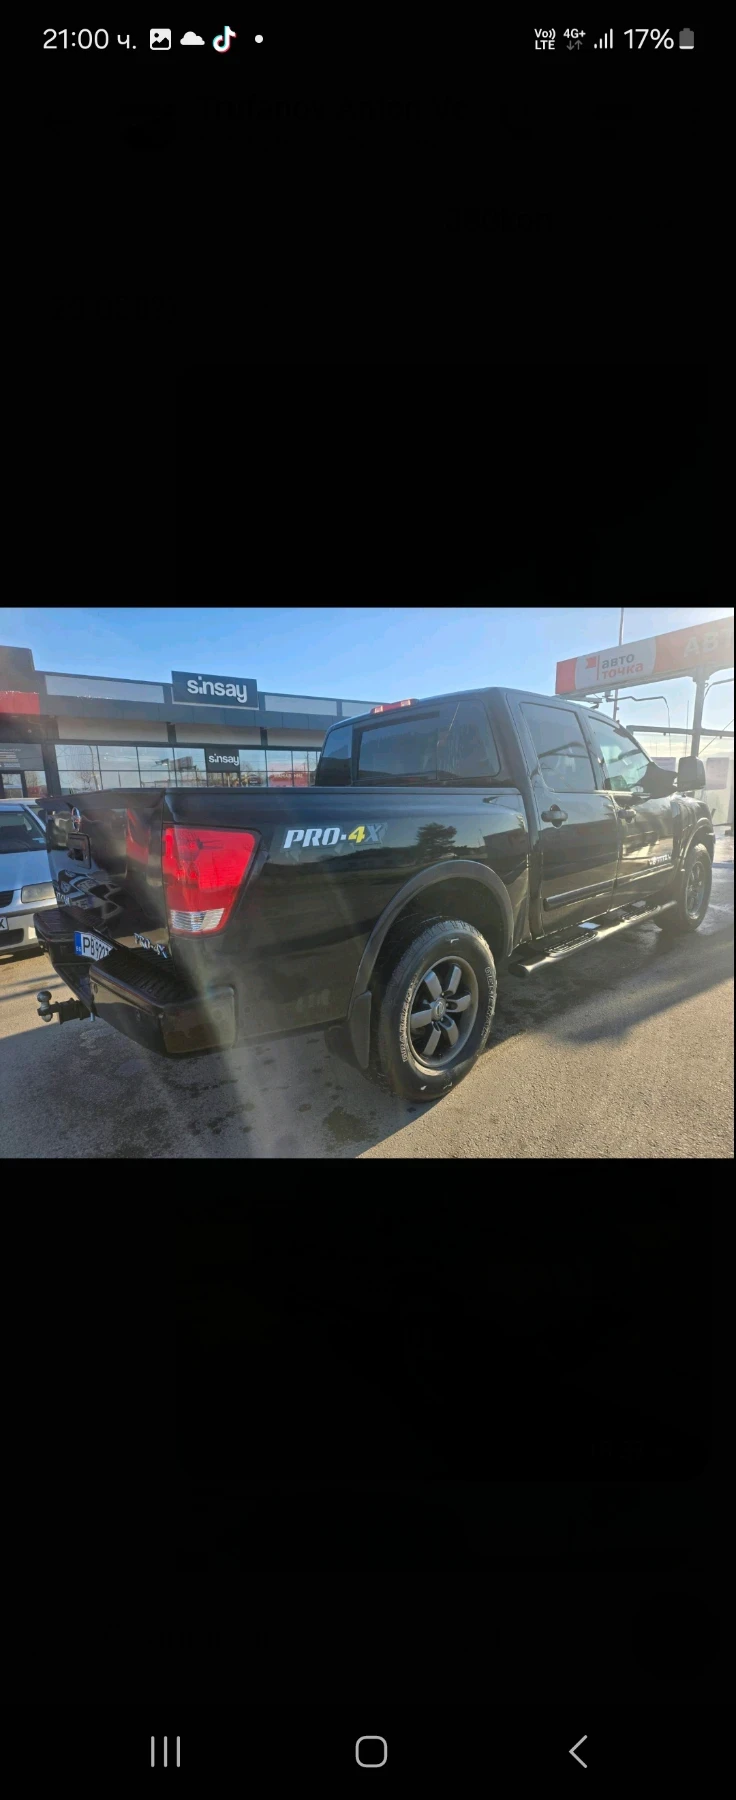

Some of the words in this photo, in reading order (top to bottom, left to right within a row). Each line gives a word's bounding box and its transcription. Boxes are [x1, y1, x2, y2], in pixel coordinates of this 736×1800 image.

[601, 653, 635, 670] авто
[602, 662, 644, 680] точка
[187, 675, 248, 703] sinsay
[208, 753, 240, 766] sinsay
